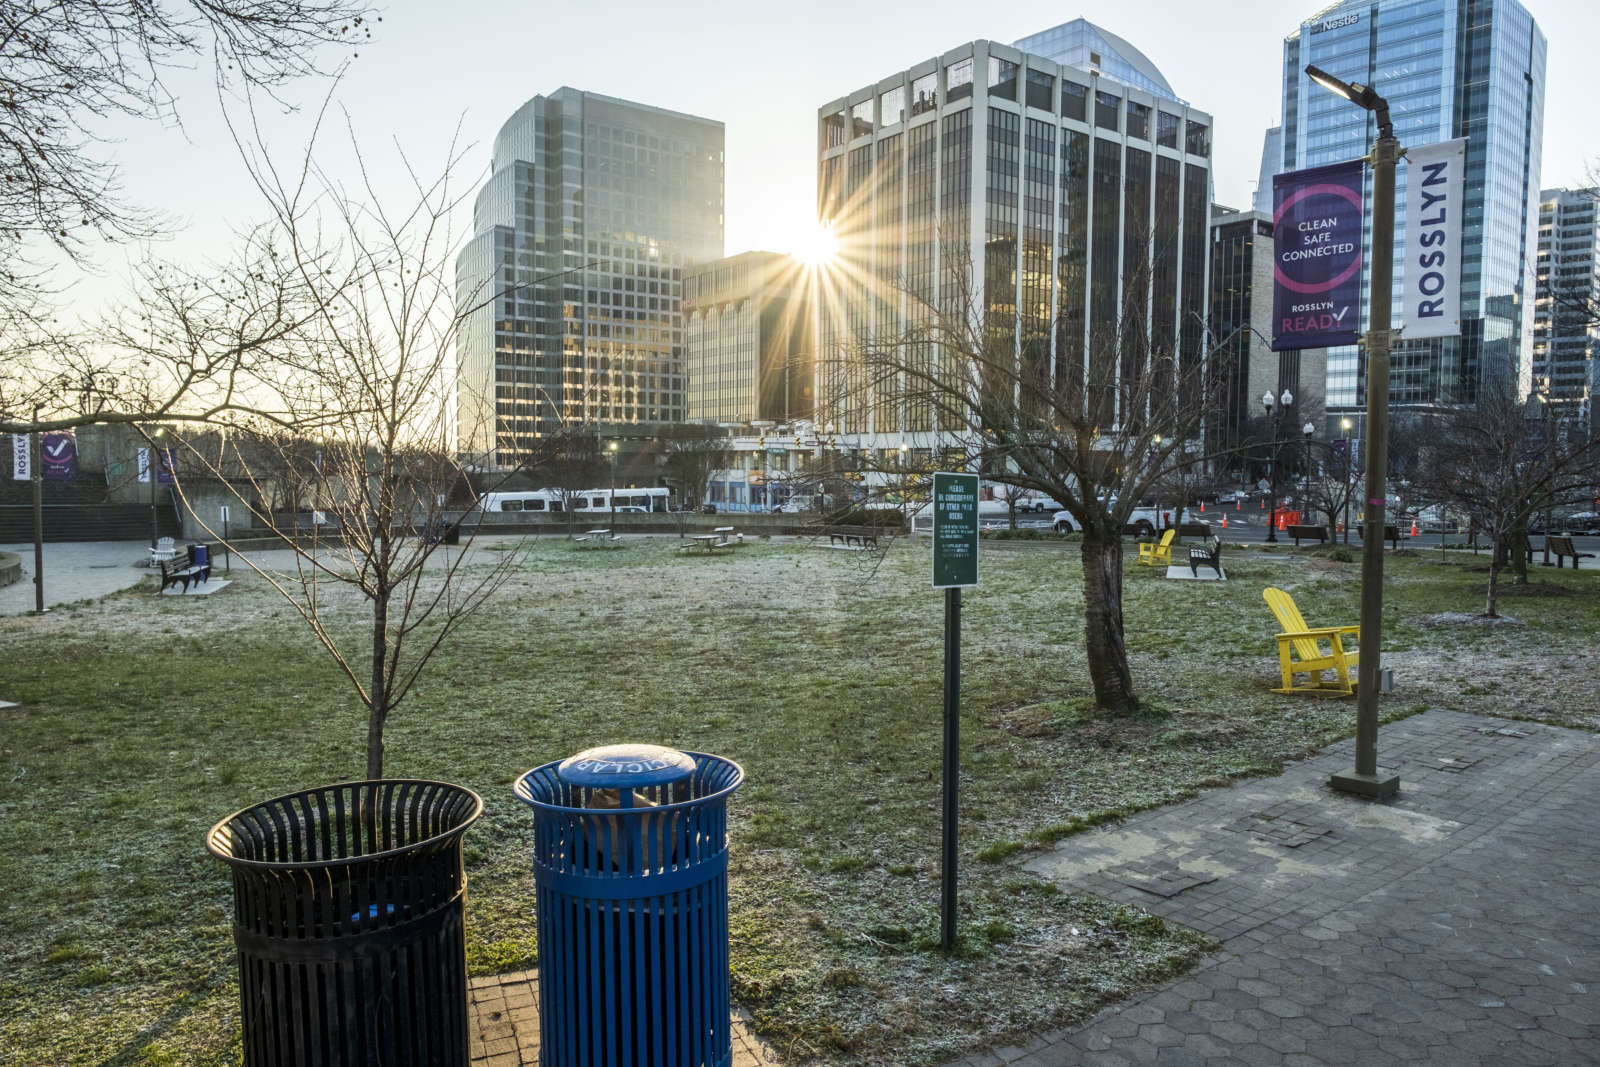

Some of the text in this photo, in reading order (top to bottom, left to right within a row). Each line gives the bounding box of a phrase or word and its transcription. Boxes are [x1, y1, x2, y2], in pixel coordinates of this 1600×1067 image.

[1298, 217, 1337, 232] CLEAN
[1304, 232, 1331, 245] SAFE
[1418, 161, 1448, 318] ROSSLYN
[1282, 243, 1354, 262] CONNECTED
[1292, 301, 1334, 312] ROSSLYN
[1282, 309, 1346, 333] READY
[576, 758, 671, 773] CICLAR
